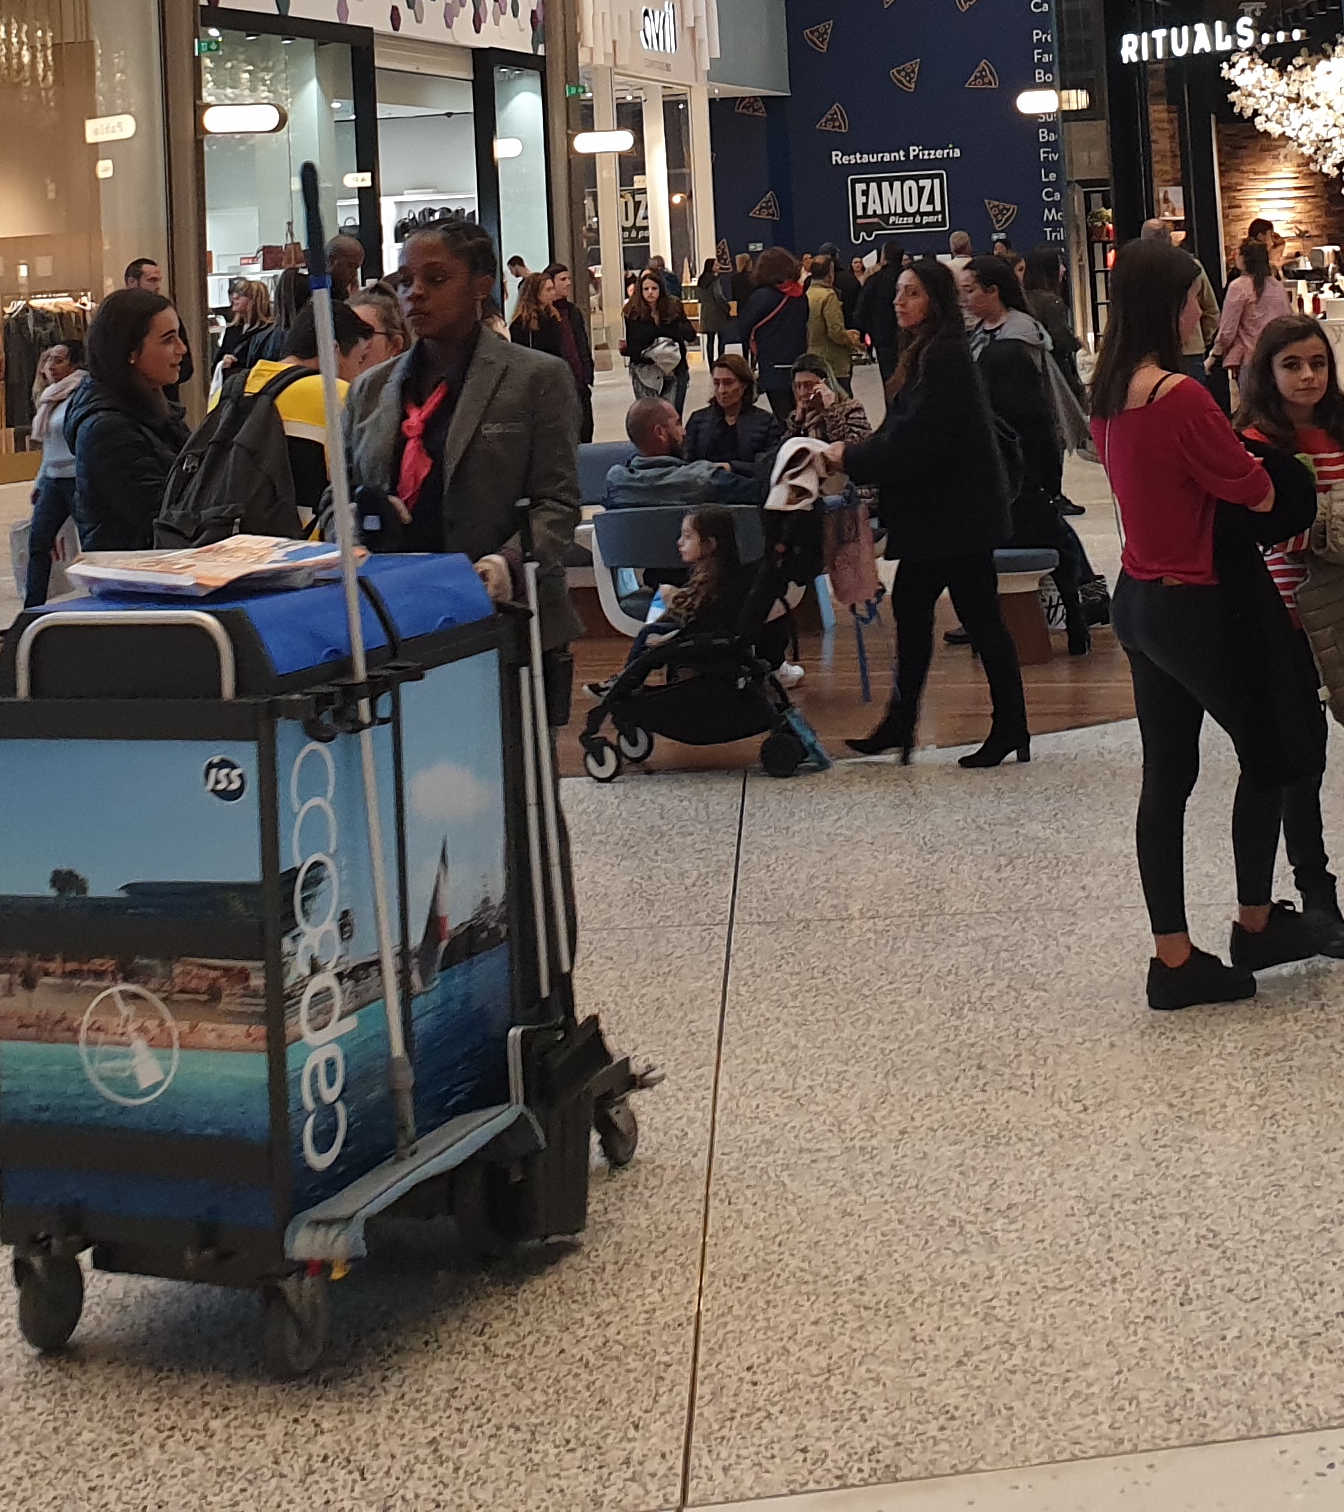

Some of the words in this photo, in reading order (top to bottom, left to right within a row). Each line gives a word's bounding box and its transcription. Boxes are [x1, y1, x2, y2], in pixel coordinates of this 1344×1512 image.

[1038, 128, 1057, 142] Ba
[831, 150, 906, 165] Restaurant
[909, 143, 961, 160] Pizzeria
[1041, 168, 1056, 182] Le
[855, 178, 942, 216] FAMOZI
[889, 216, 914, 225] Pizza
[922, 214, 942, 225] part
